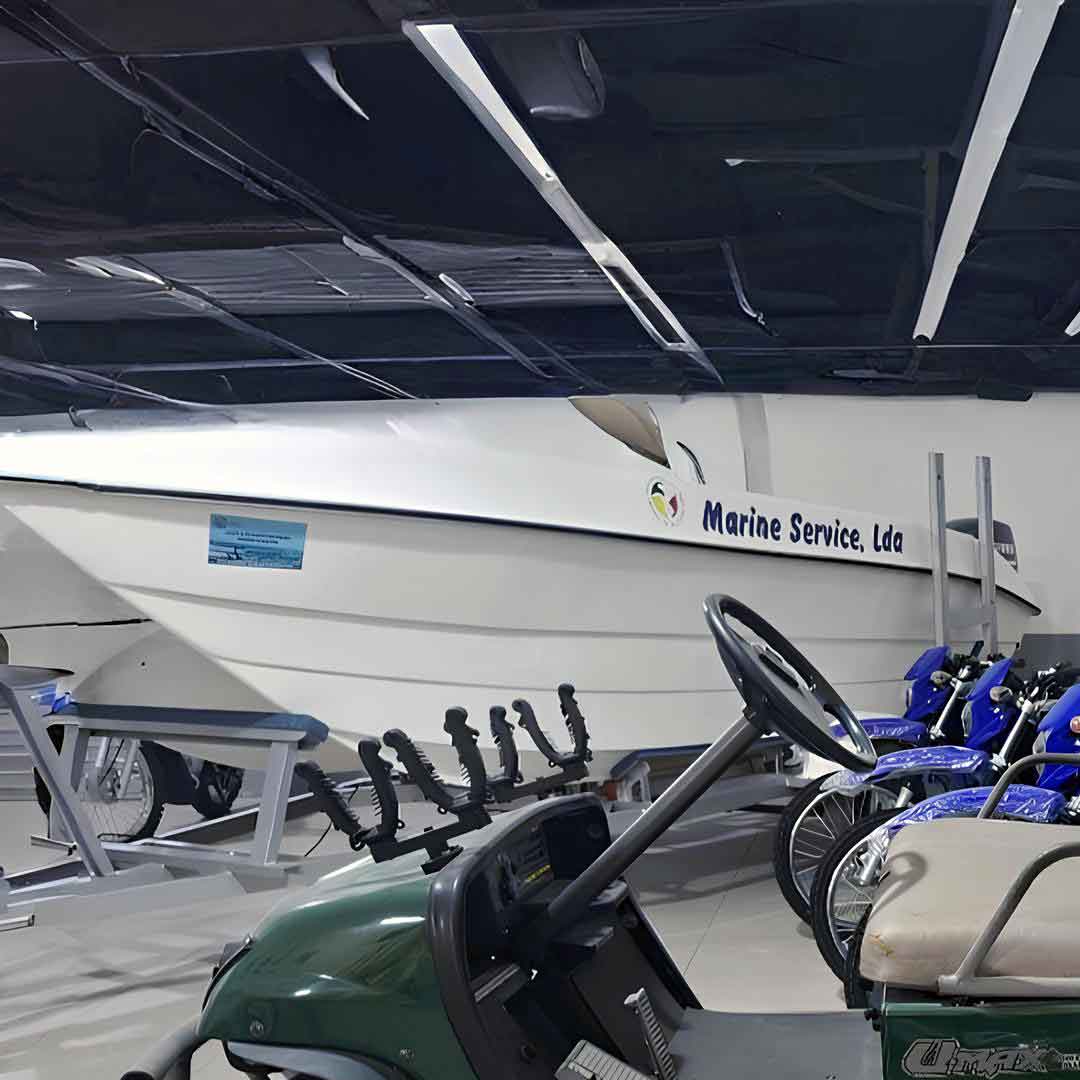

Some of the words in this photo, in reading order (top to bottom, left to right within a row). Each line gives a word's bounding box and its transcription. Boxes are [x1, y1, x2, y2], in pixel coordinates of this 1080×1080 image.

[702, 500, 782, 541] Marine
[789, 512, 865, 553] Service,
[873, 523, 904, 554] Lda
